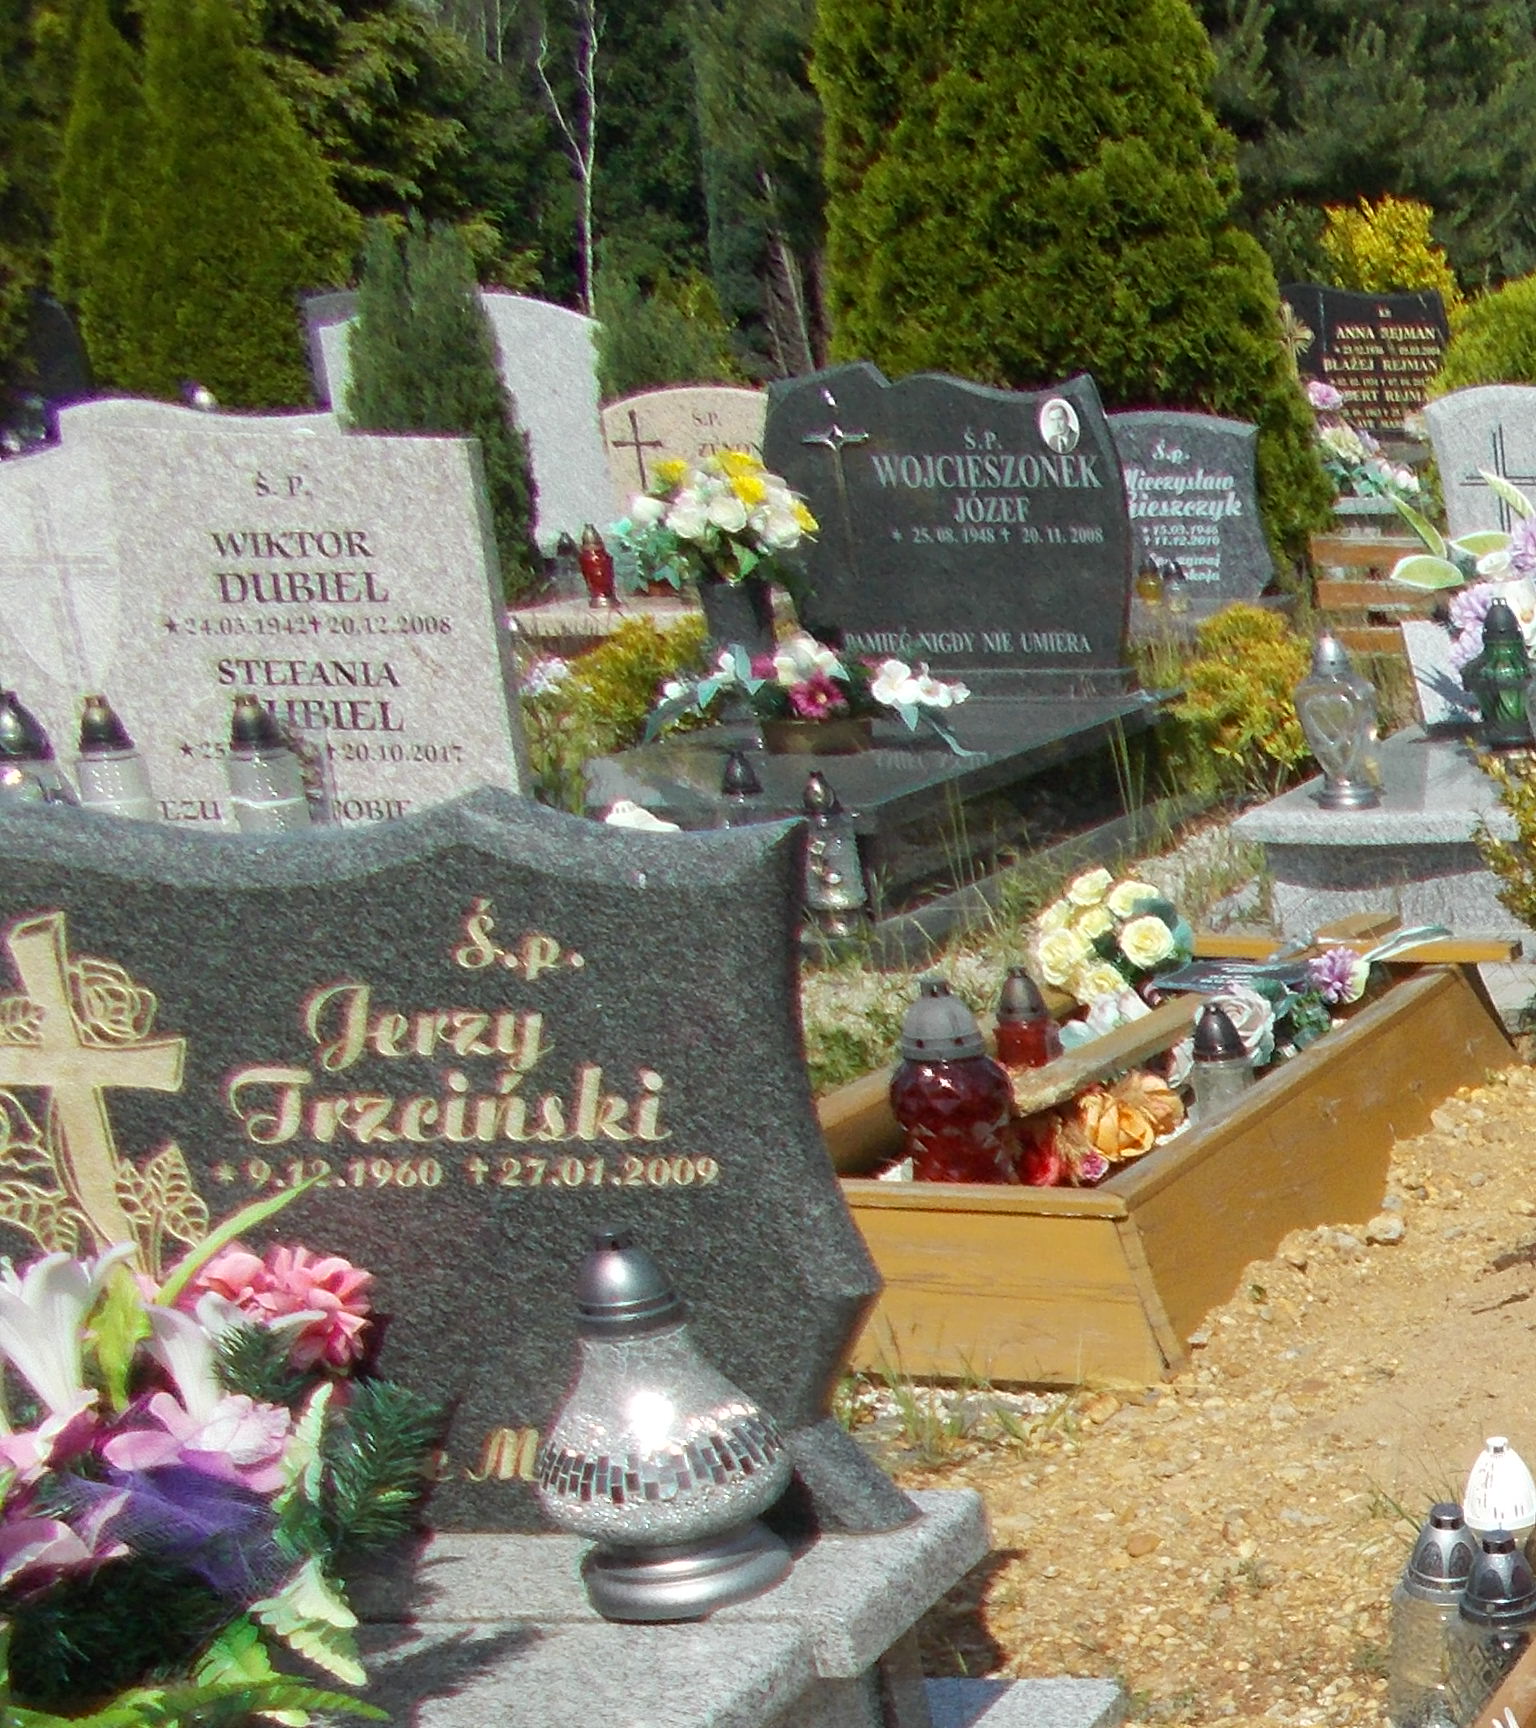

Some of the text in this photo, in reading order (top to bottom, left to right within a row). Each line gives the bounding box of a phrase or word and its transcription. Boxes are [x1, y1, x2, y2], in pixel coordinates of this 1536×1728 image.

[963, 426, 1002, 450] Ś.P.
[872, 454, 1103, 489] WOJCIESZONEK
[954, 490, 1030, 523] JÓZEF
[211, 531, 376, 559] WIKTOR
[214, 571, 390, 603] DUBIEL
[917, 632, 976, 654] NIGDY
[982, 632, 1014, 654] NIE
[1021, 632, 1093, 654] UMIERA
[218, 658, 401, 688] STEFANIA
[240, 698, 405, 731] UBIEL
[455, 898, 585, 981] Ś.p.
[304, 983, 554, 1072] Jerzy
[226, 1063, 673, 1144] Trzciński
[502, 1158, 720, 1188] 27.01.2009
